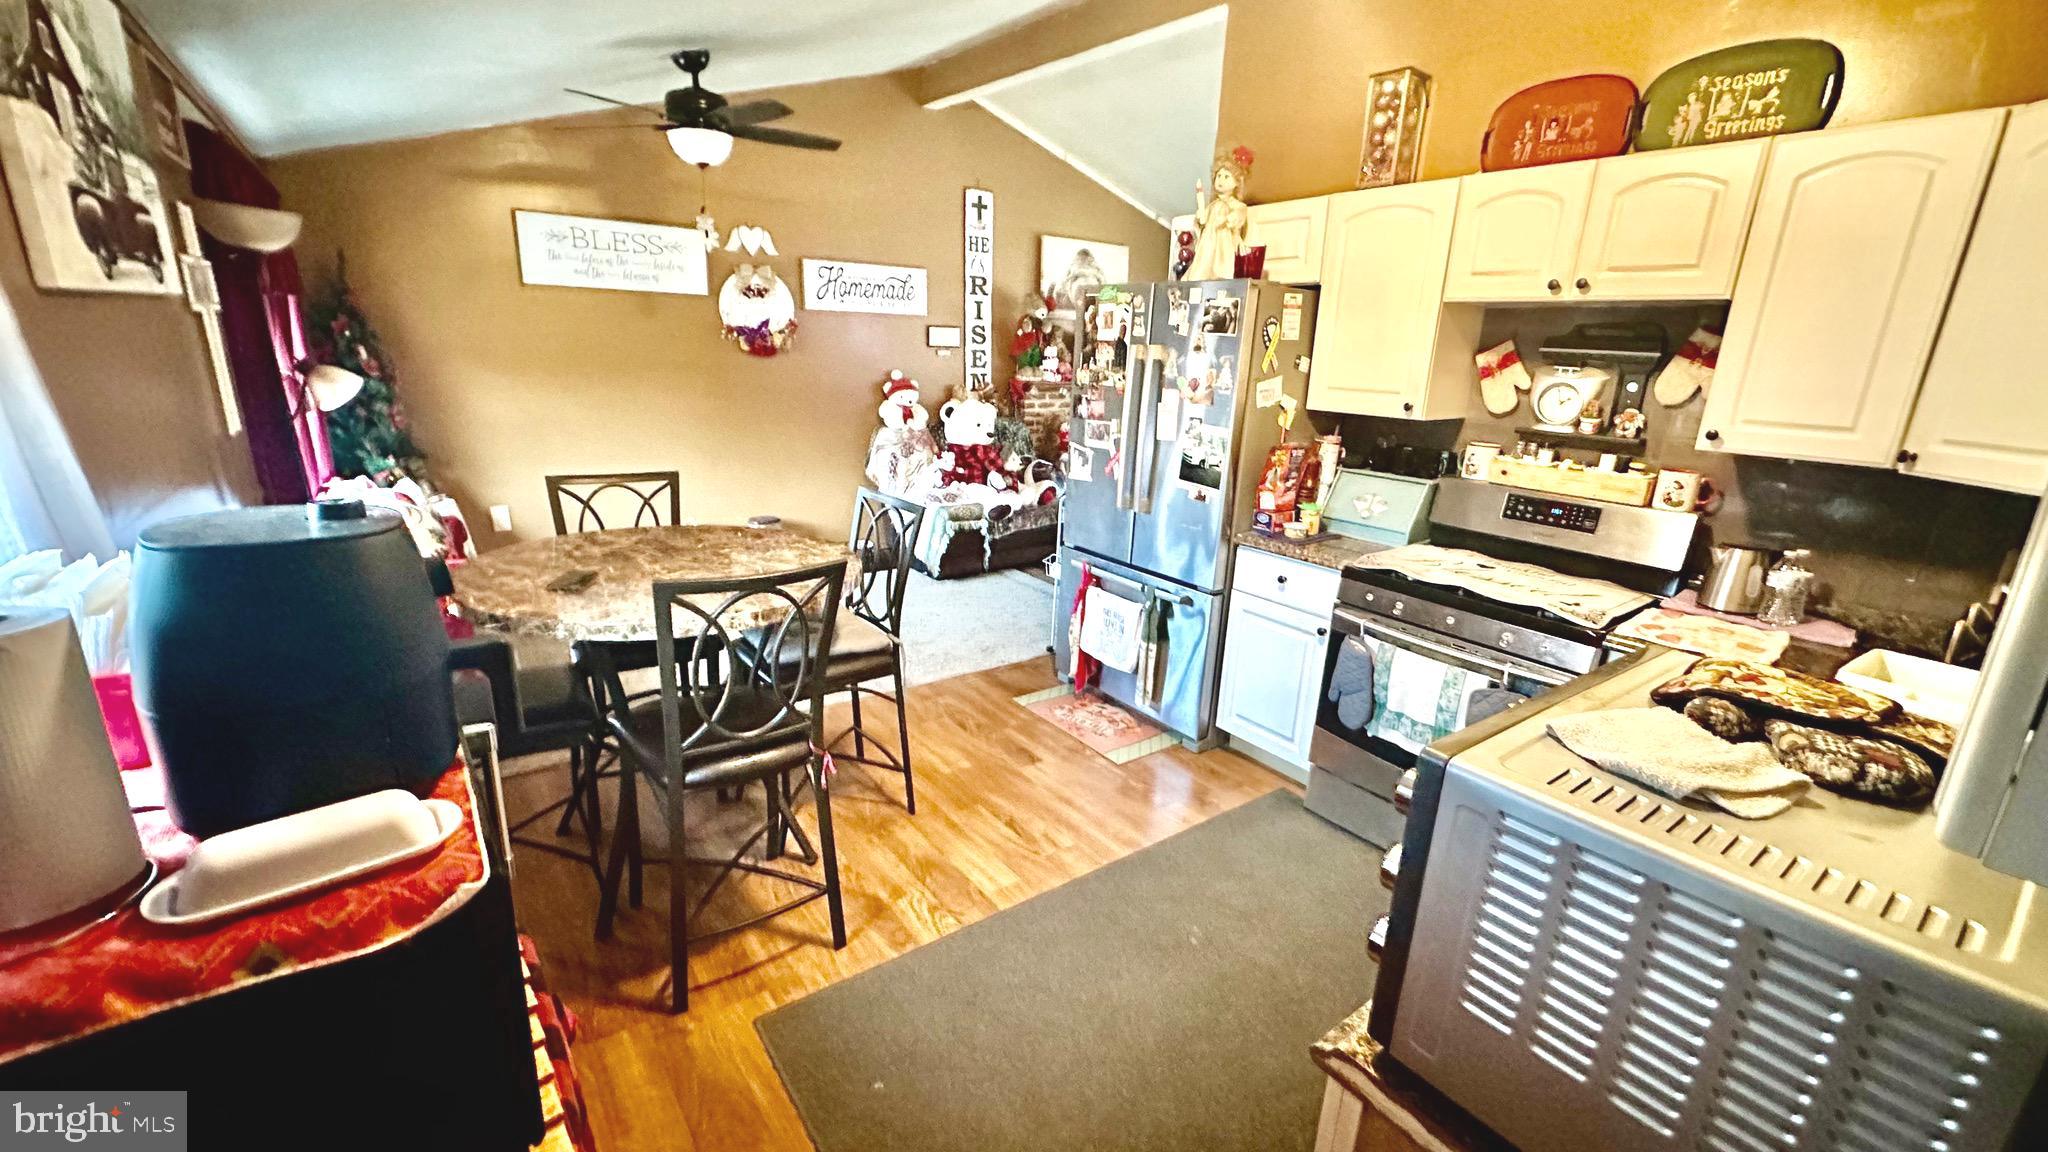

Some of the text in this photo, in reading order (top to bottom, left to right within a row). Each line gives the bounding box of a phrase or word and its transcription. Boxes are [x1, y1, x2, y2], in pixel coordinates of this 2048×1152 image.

[1712, 67, 1791, 91] Season's
[1703, 114, 1787, 139] Greetings
[570, 225, 664, 256] BLESS
[969, 236, 989, 254] HE
[970, 255, 985, 274] is
[816, 265, 915, 301] Homemade
[969, 275, 989, 391] RISEN
